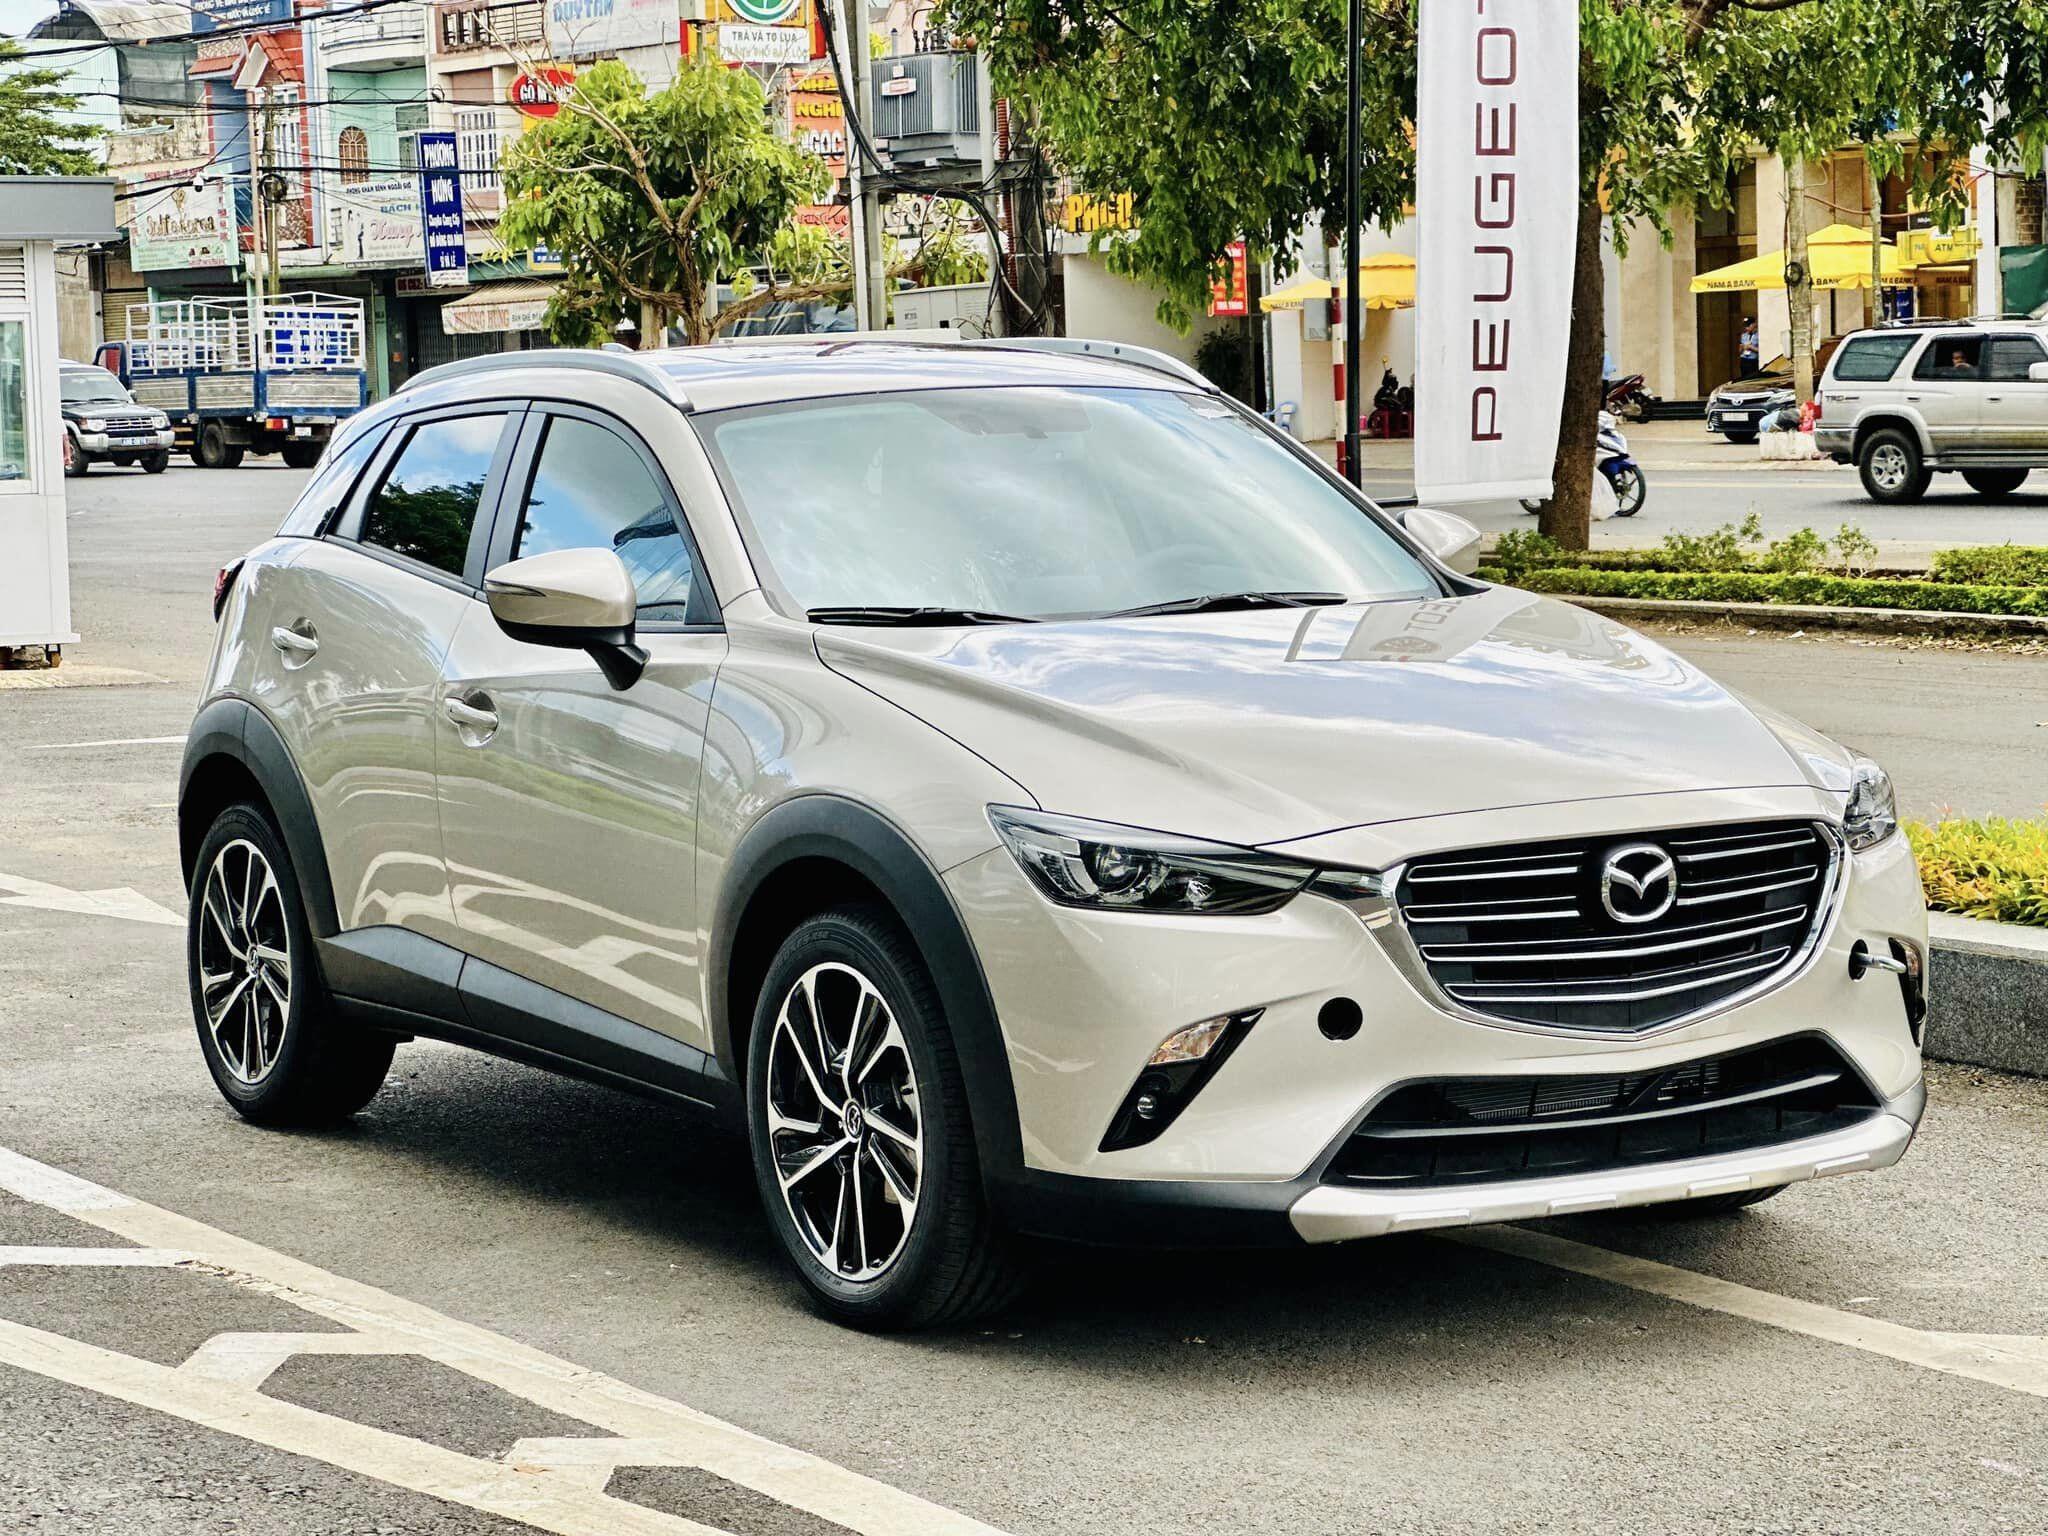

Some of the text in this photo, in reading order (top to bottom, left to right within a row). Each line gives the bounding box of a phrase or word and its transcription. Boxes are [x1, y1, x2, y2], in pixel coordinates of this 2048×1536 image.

[1471, 0, 1519, 443] PEUGEO
[1707, 281, 1726, 289] NAM
[1734, 280, 1756, 288] BANK
